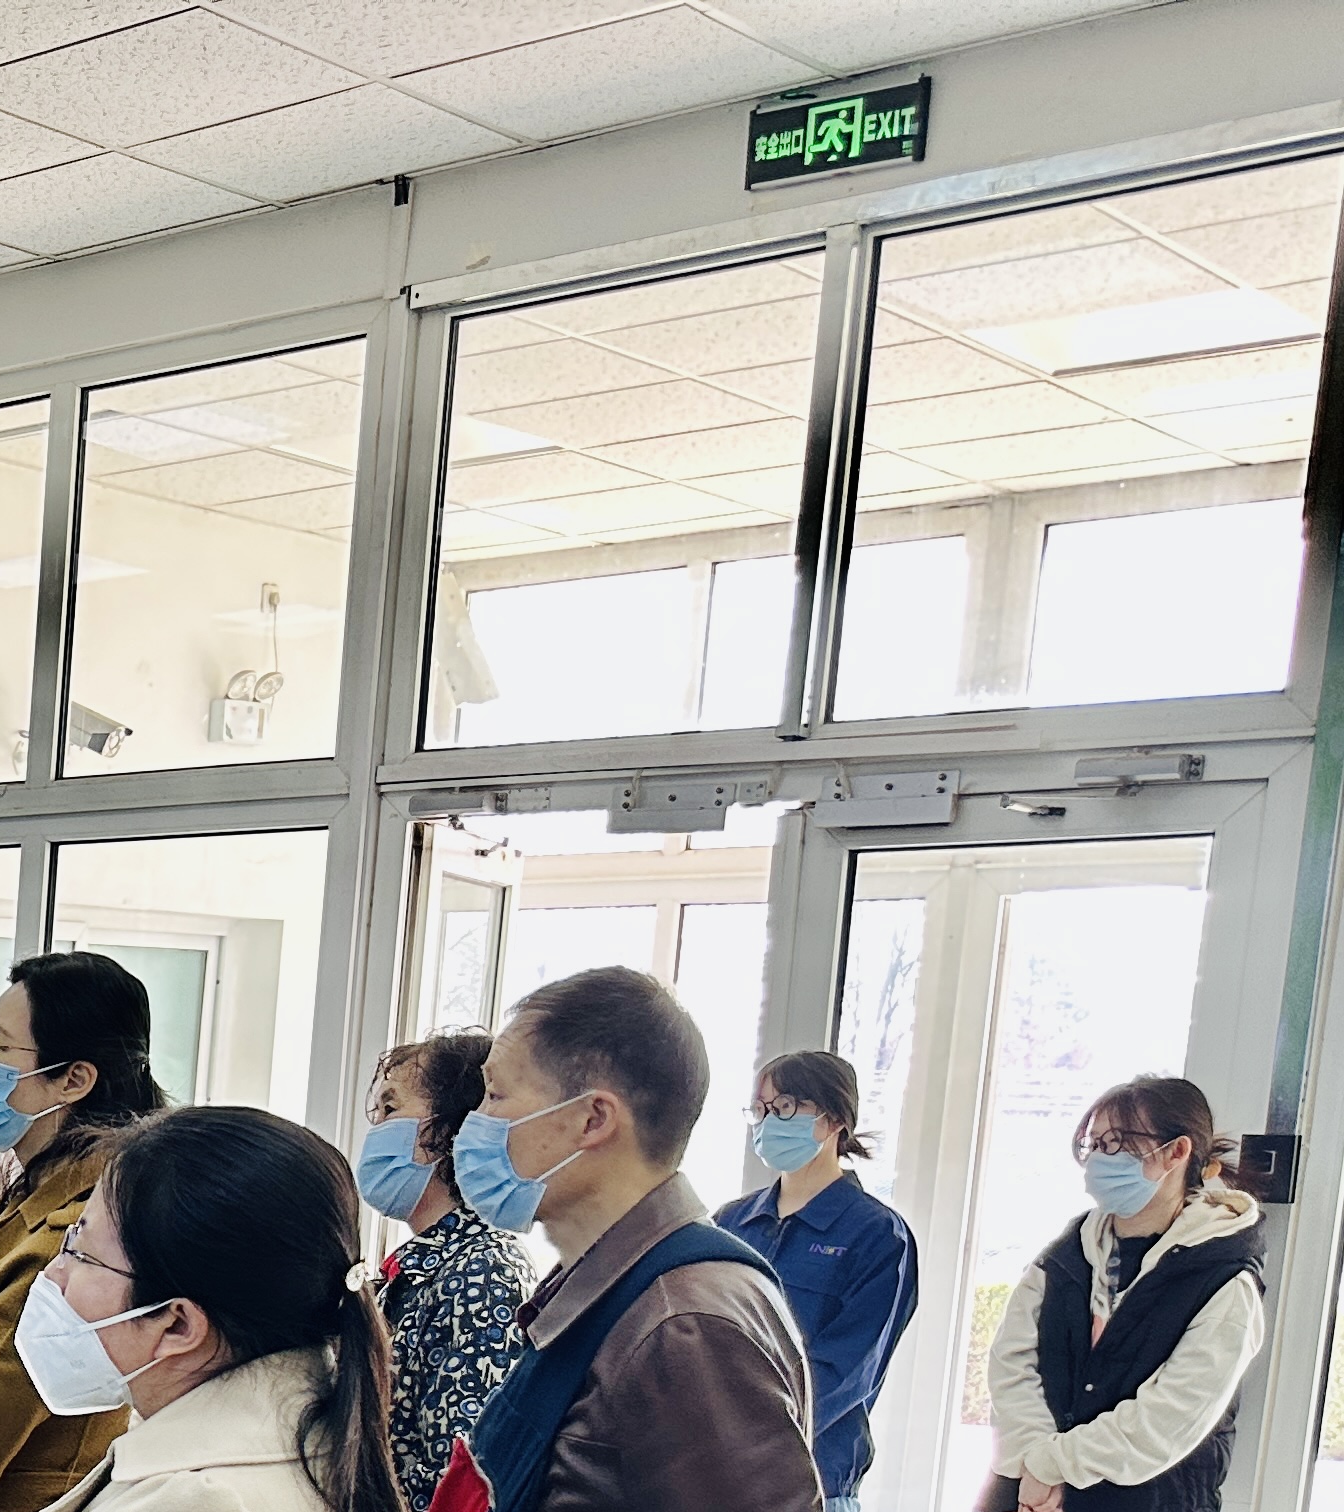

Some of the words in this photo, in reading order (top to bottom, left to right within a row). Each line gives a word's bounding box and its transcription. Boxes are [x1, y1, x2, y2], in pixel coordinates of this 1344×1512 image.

[863, 106, 916, 143] EXIT
[754, 128, 804, 162] 安全出口
